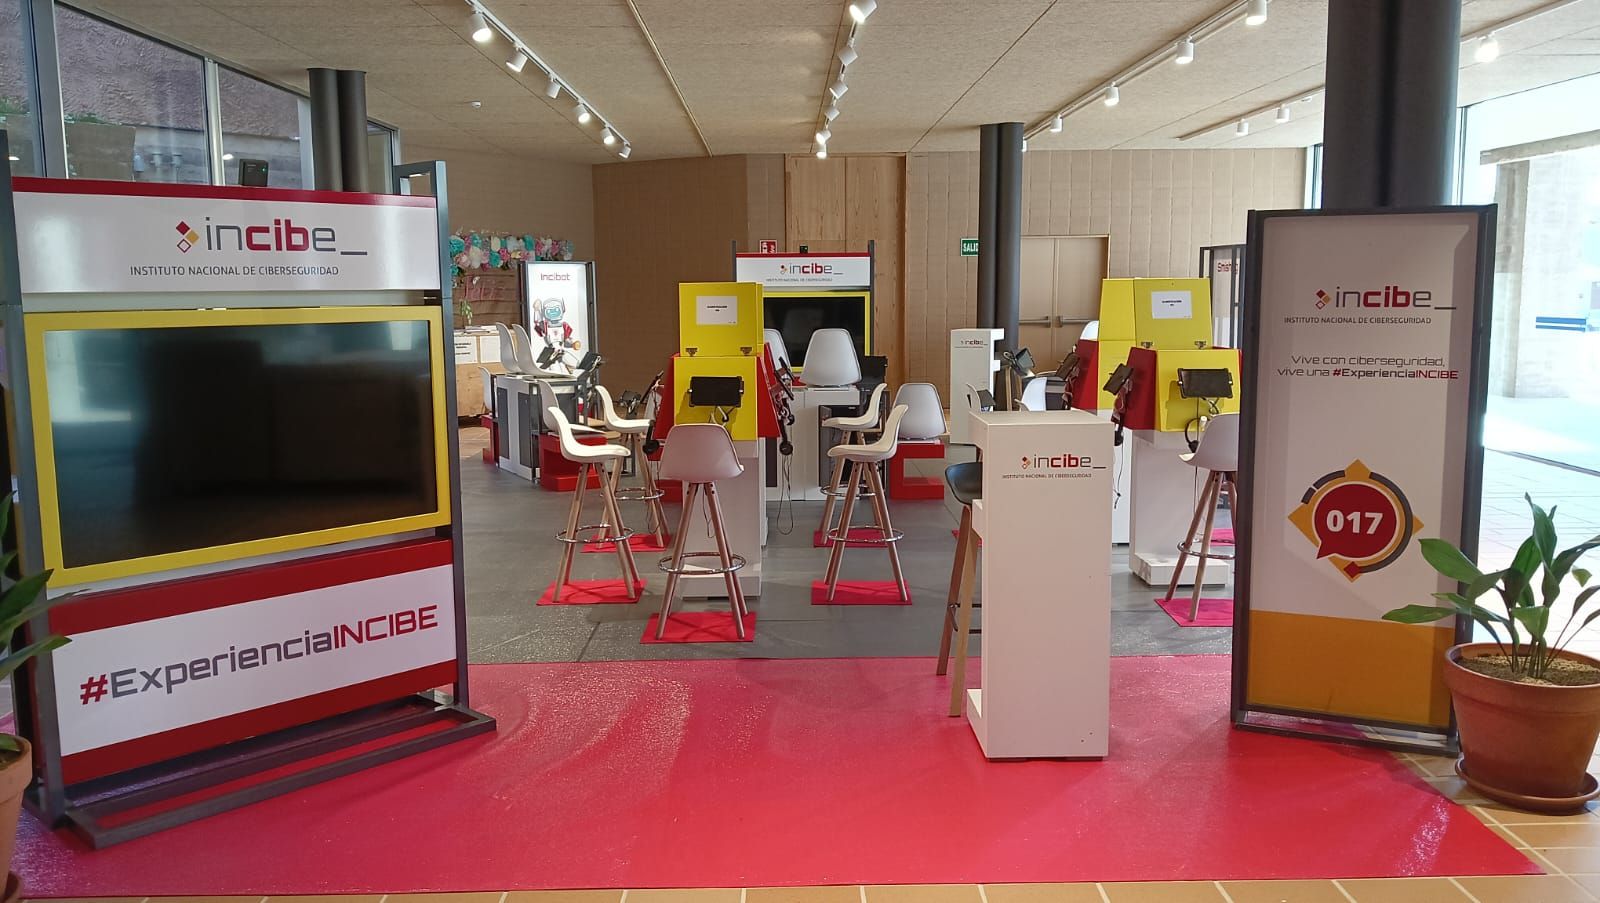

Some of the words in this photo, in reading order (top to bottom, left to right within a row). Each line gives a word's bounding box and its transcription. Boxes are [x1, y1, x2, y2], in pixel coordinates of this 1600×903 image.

[130, 266, 185, 276] INSTITUTO
[188, 266, 240, 276] NACIONAL
[243, 266, 256, 276] DE
[258, 266, 339, 276] CIBERSEGURIDAD
[1291, 355, 1320, 365] Vive
[1323, 356, 1346, 365] con
[1348, 355, 1445, 368] ciberseguridad,
[1277, 368, 1304, 377] vive
[1307, 369, 1330, 377] una
[1332, 368, 1459, 380] #ExperienciaINCIBE
[1326, 509, 1384, 535] 017
[79, 605, 438, 705] #ExperienciaINCIBE
